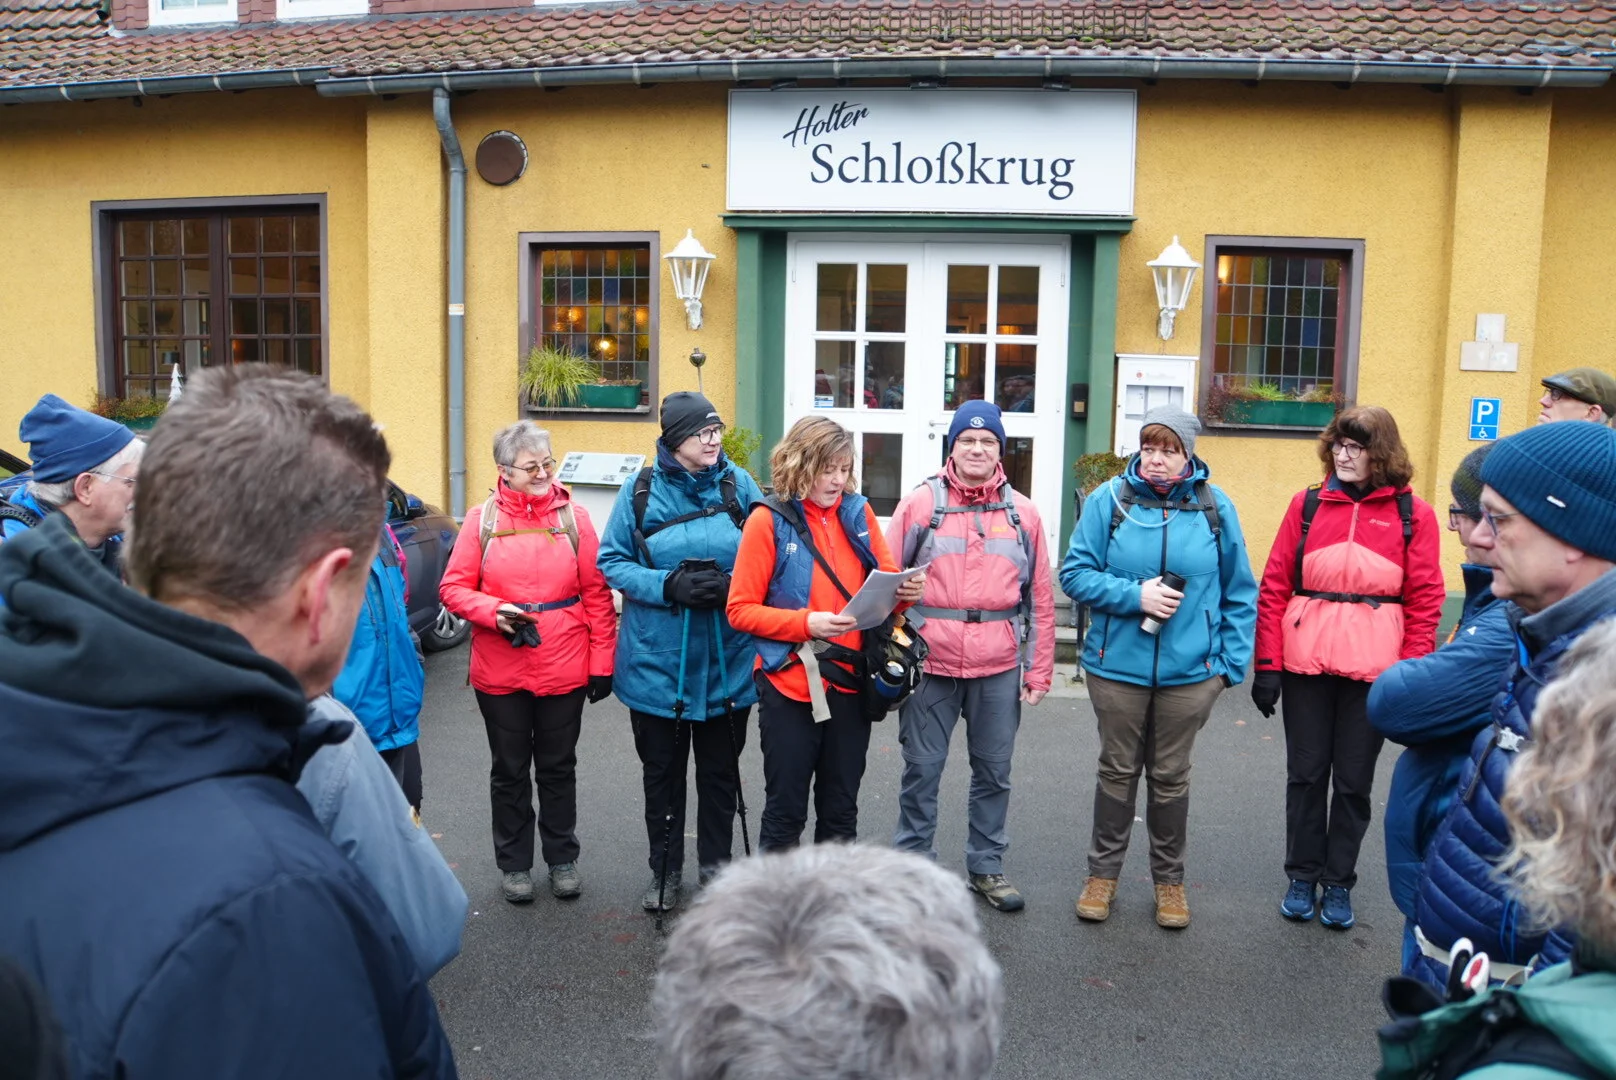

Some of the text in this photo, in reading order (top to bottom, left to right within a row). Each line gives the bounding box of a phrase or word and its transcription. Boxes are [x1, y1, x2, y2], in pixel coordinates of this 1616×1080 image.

[783, 101, 869, 148] Holter
[810, 141, 1076, 201] Schloßkrug
[1477, 401, 1494, 423] P
